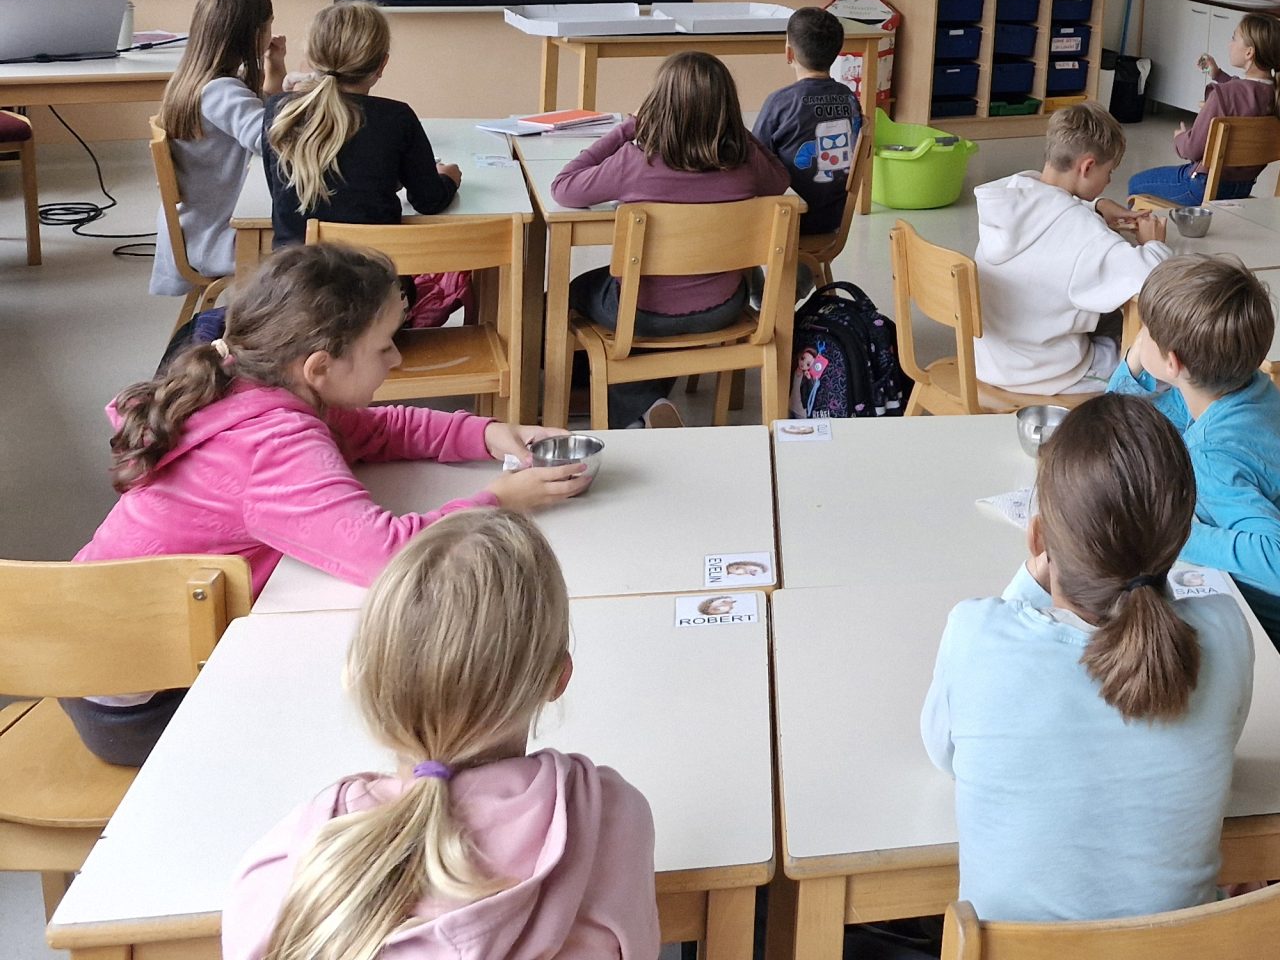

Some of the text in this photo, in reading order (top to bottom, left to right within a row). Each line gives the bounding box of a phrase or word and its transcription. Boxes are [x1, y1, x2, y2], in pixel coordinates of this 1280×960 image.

[814, 104, 851, 118] OVER
[708, 556, 723, 584] EVELIN
[1176, 587, 1218, 596] SARA
[679, 613, 755, 626] ROBERT
